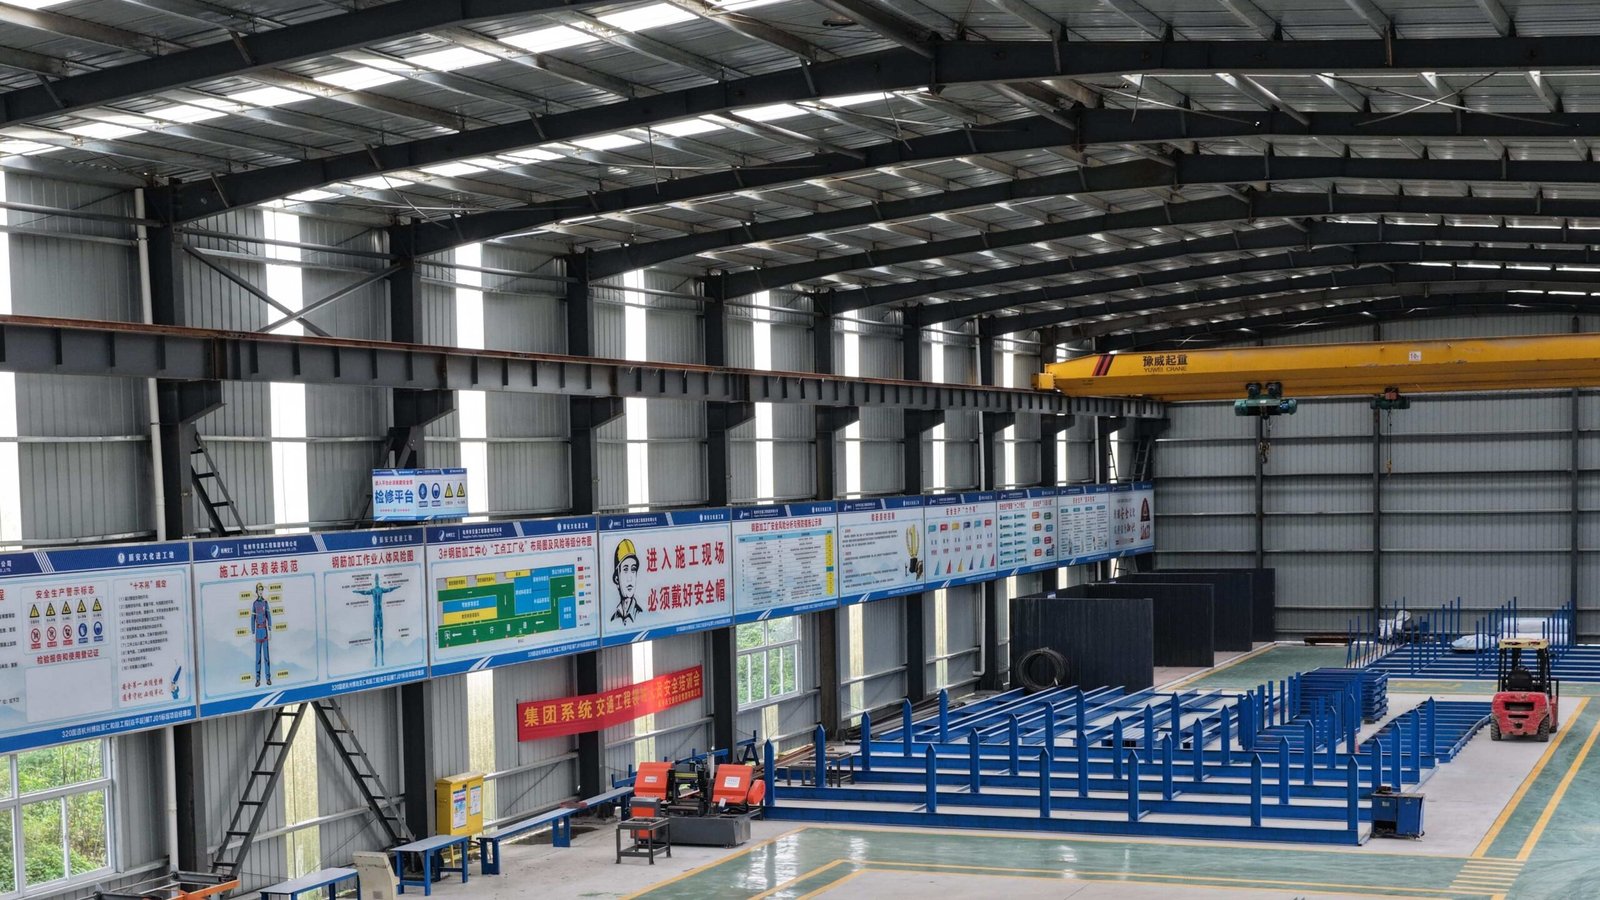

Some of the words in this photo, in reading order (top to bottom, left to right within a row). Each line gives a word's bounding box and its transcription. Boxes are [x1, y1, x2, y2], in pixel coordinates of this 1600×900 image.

[1143, 354, 1188, 367] 豫威起重
[375, 489, 413, 504] 检修平台
[332, 549, 414, 569] 钢筋加工作业人体风险图
[646, 541, 725, 573] 进入施工现场
[219, 560, 299, 579] 施工人员着装规范
[36, 585, 95, 600] 安全生产警示标志
[647, 578, 726, 613] 必须戴好安全帽
[37, 649, 100, 665] 检验报告和使用登记证
